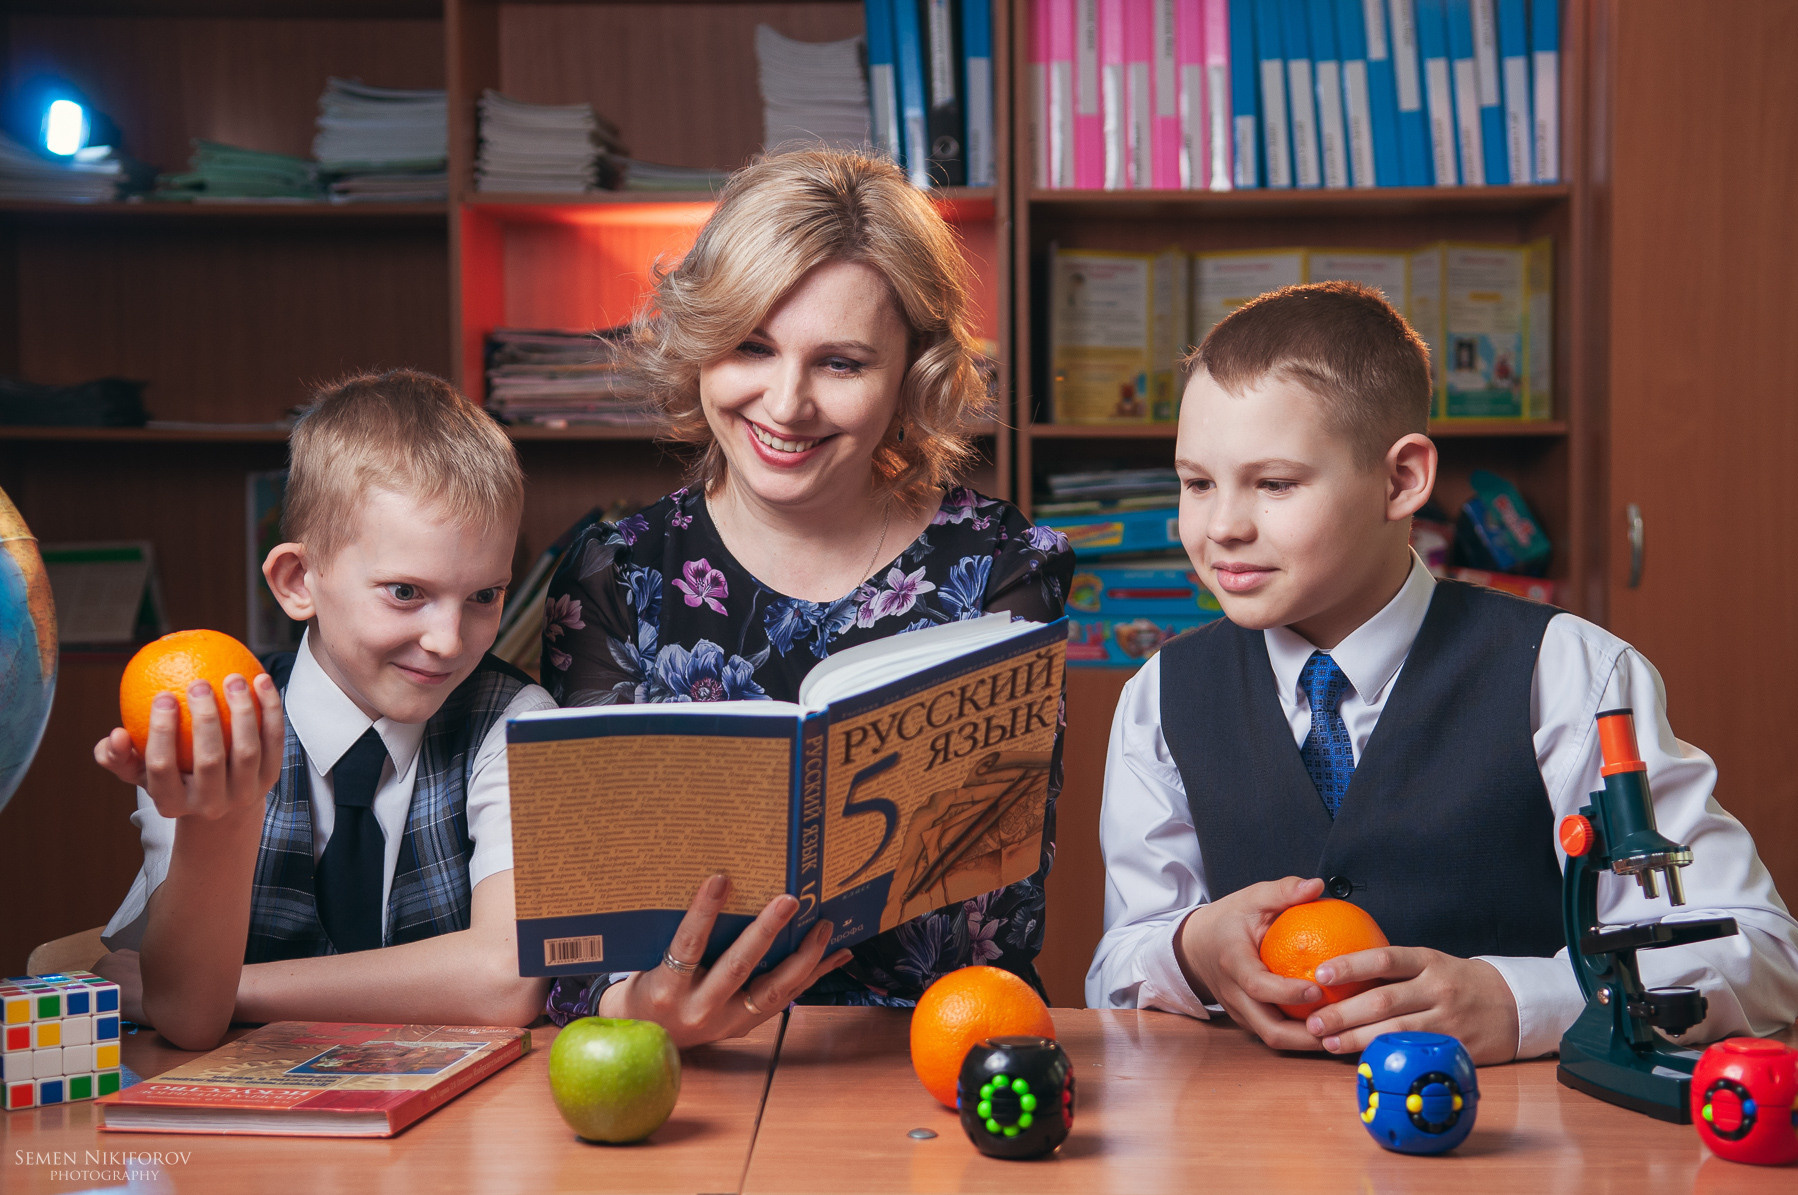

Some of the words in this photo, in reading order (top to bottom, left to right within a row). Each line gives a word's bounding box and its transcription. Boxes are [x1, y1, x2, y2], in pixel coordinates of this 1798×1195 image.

[841, 648, 1058, 765] РУССКИЙ
[923, 695, 1054, 772] ЯЗЫК
[803, 734, 824, 822] РУССКИЙ
[836, 750, 901, 887] 5
[801, 825, 821, 876] ЯЗЫК
[799, 880, 817, 920] 5
